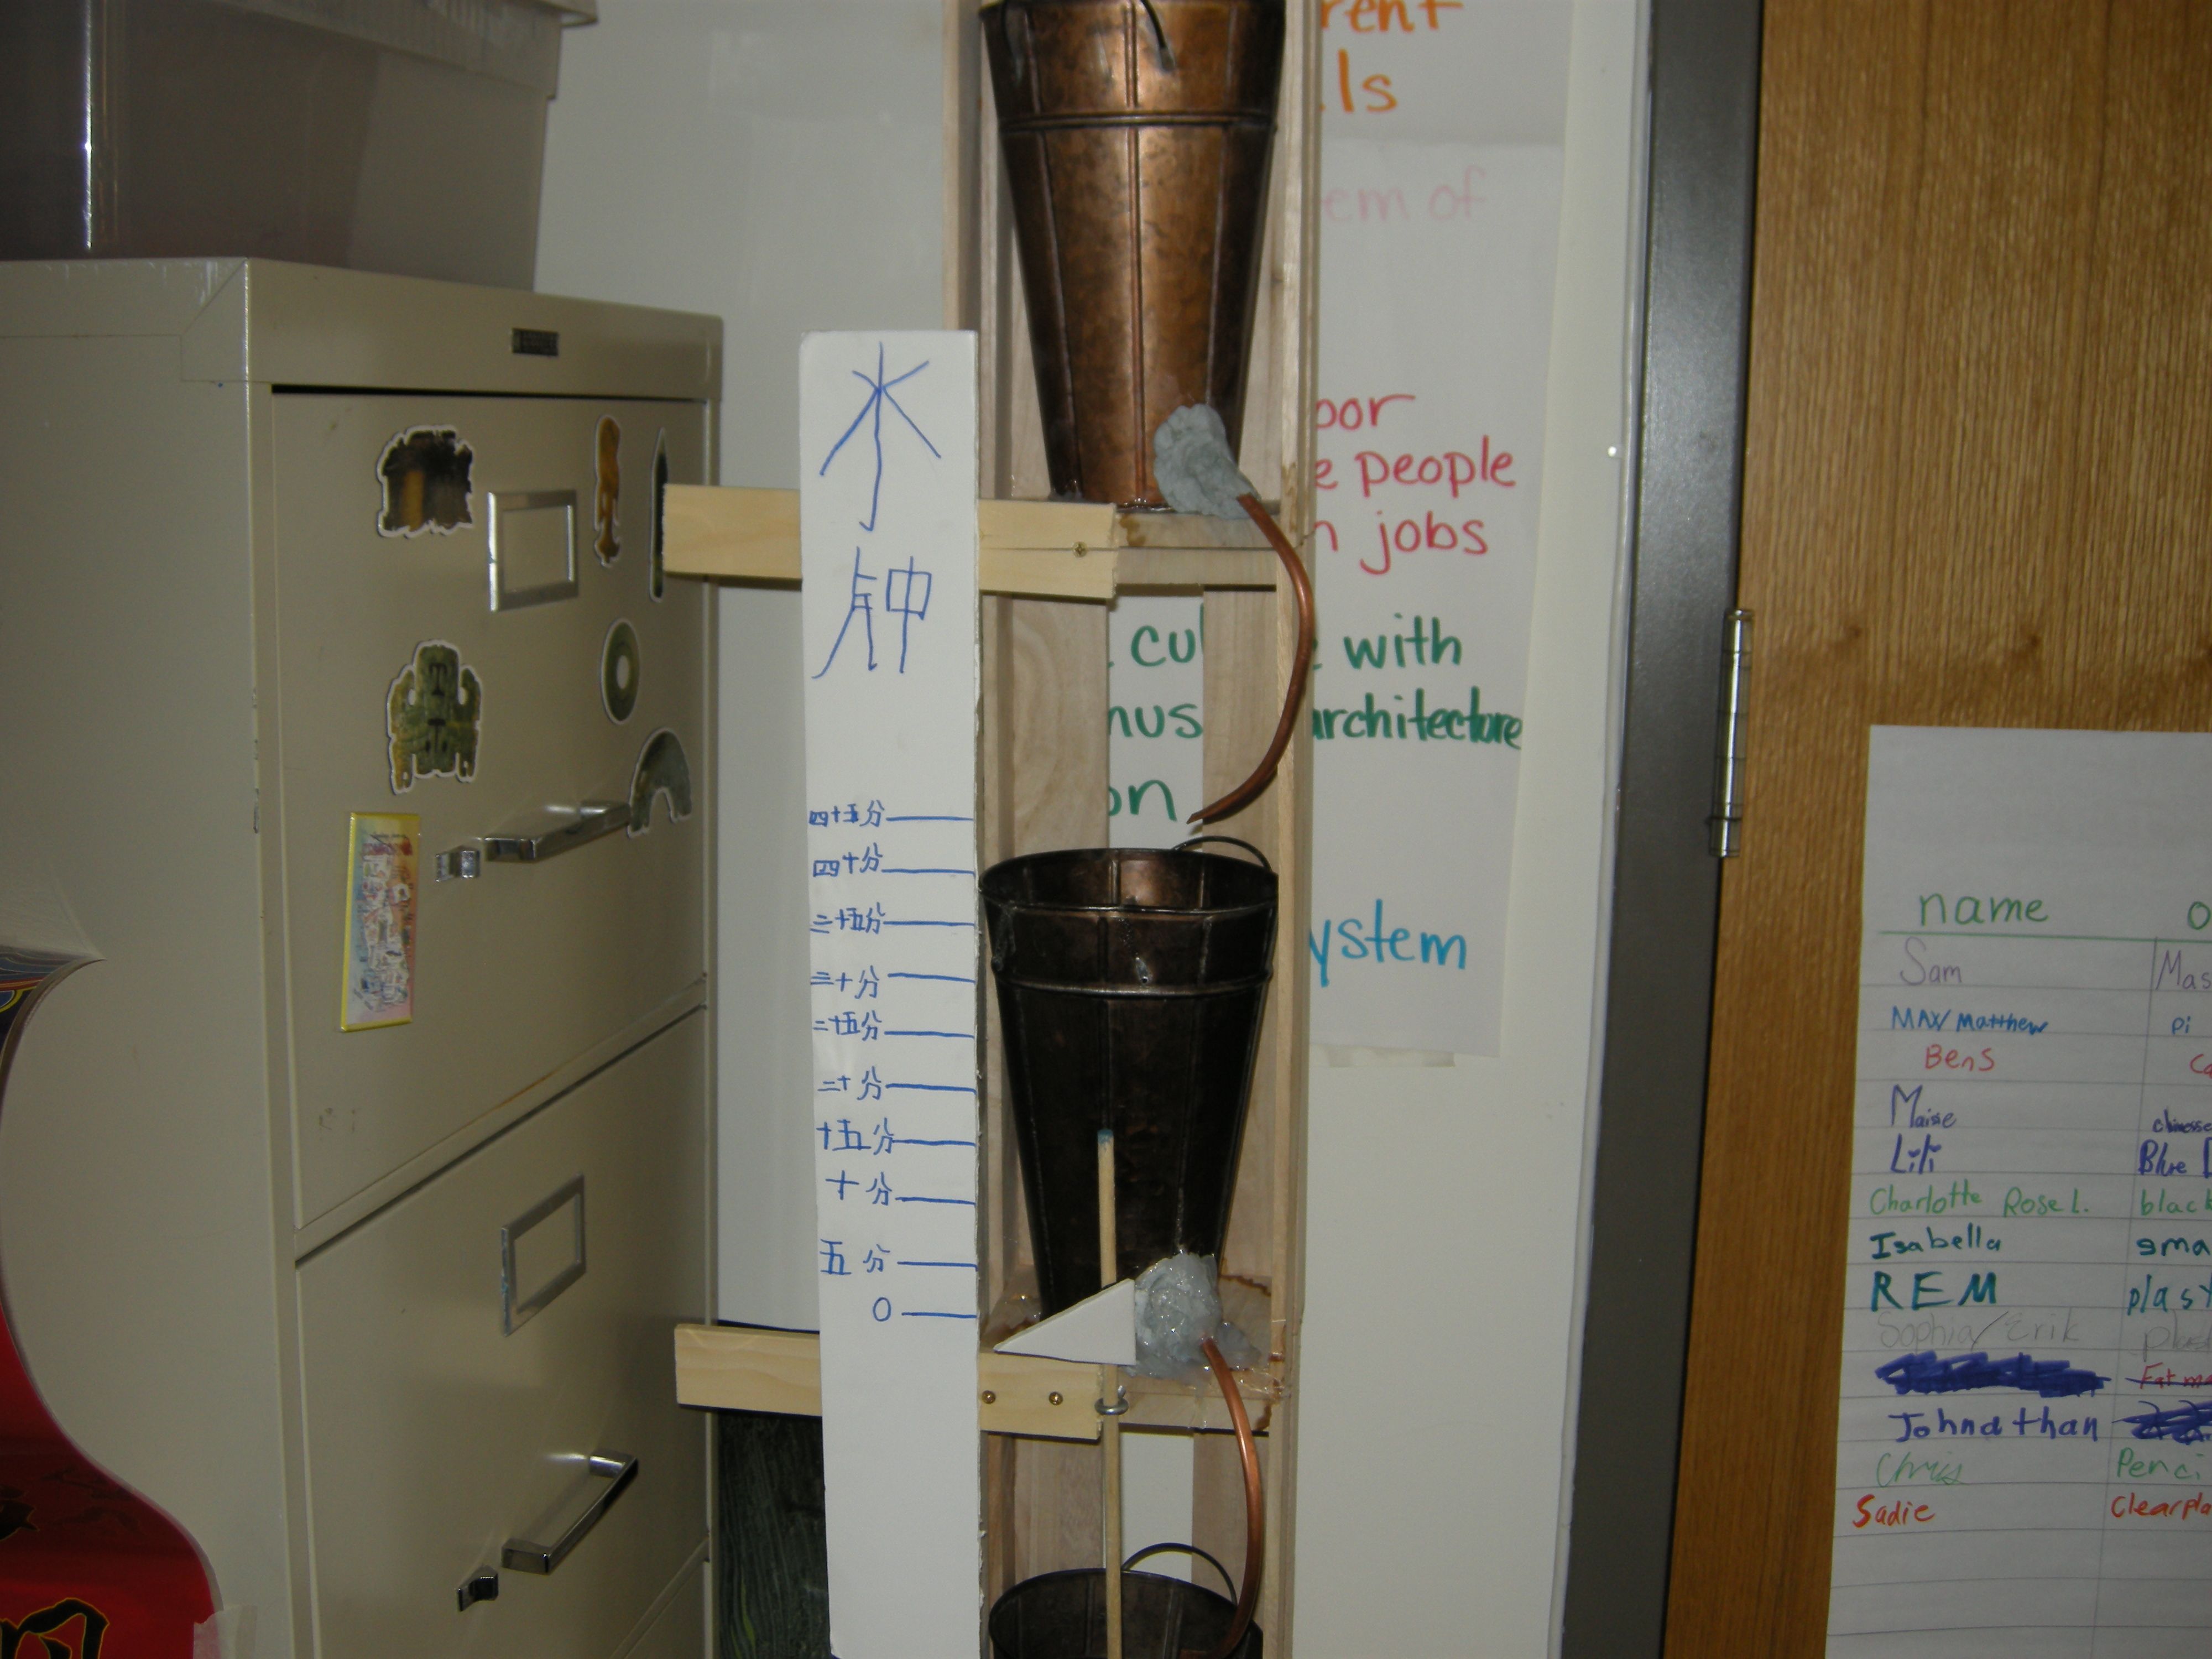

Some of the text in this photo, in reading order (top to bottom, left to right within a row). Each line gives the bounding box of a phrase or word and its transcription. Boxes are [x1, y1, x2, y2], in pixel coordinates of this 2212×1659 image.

[1428, 165, 1488, 223] of
[1354, 434, 1516, 498] people
[1359, 510, 1488, 575] jobs
[1344, 613, 1463, 670] with
[813, 842, 883, 877] 四十分
[1919, 893, 2049, 927] name
[1900, 936, 1963, 987] Sam
[810, 965, 880, 999] 三十分
[817, 1066, 882, 1100] 二十分
[816, 1117, 894, 1155] 十五分
[2137, 1139, 2188, 1177] Blue
[825, 1170, 893, 1206] 十分
[1870, 1179, 1983, 1216] Charlotte
[2003, 1186, 2064, 1218] Rose
[820, 1238, 890, 1276] 五分
[1870, 1222, 2001, 1260] Isabella
[1870, 1271, 1998, 1312] REM
[1888, 1406, 2100, 1442] Johnathan
[1853, 1494, 1936, 1528] Sadie
